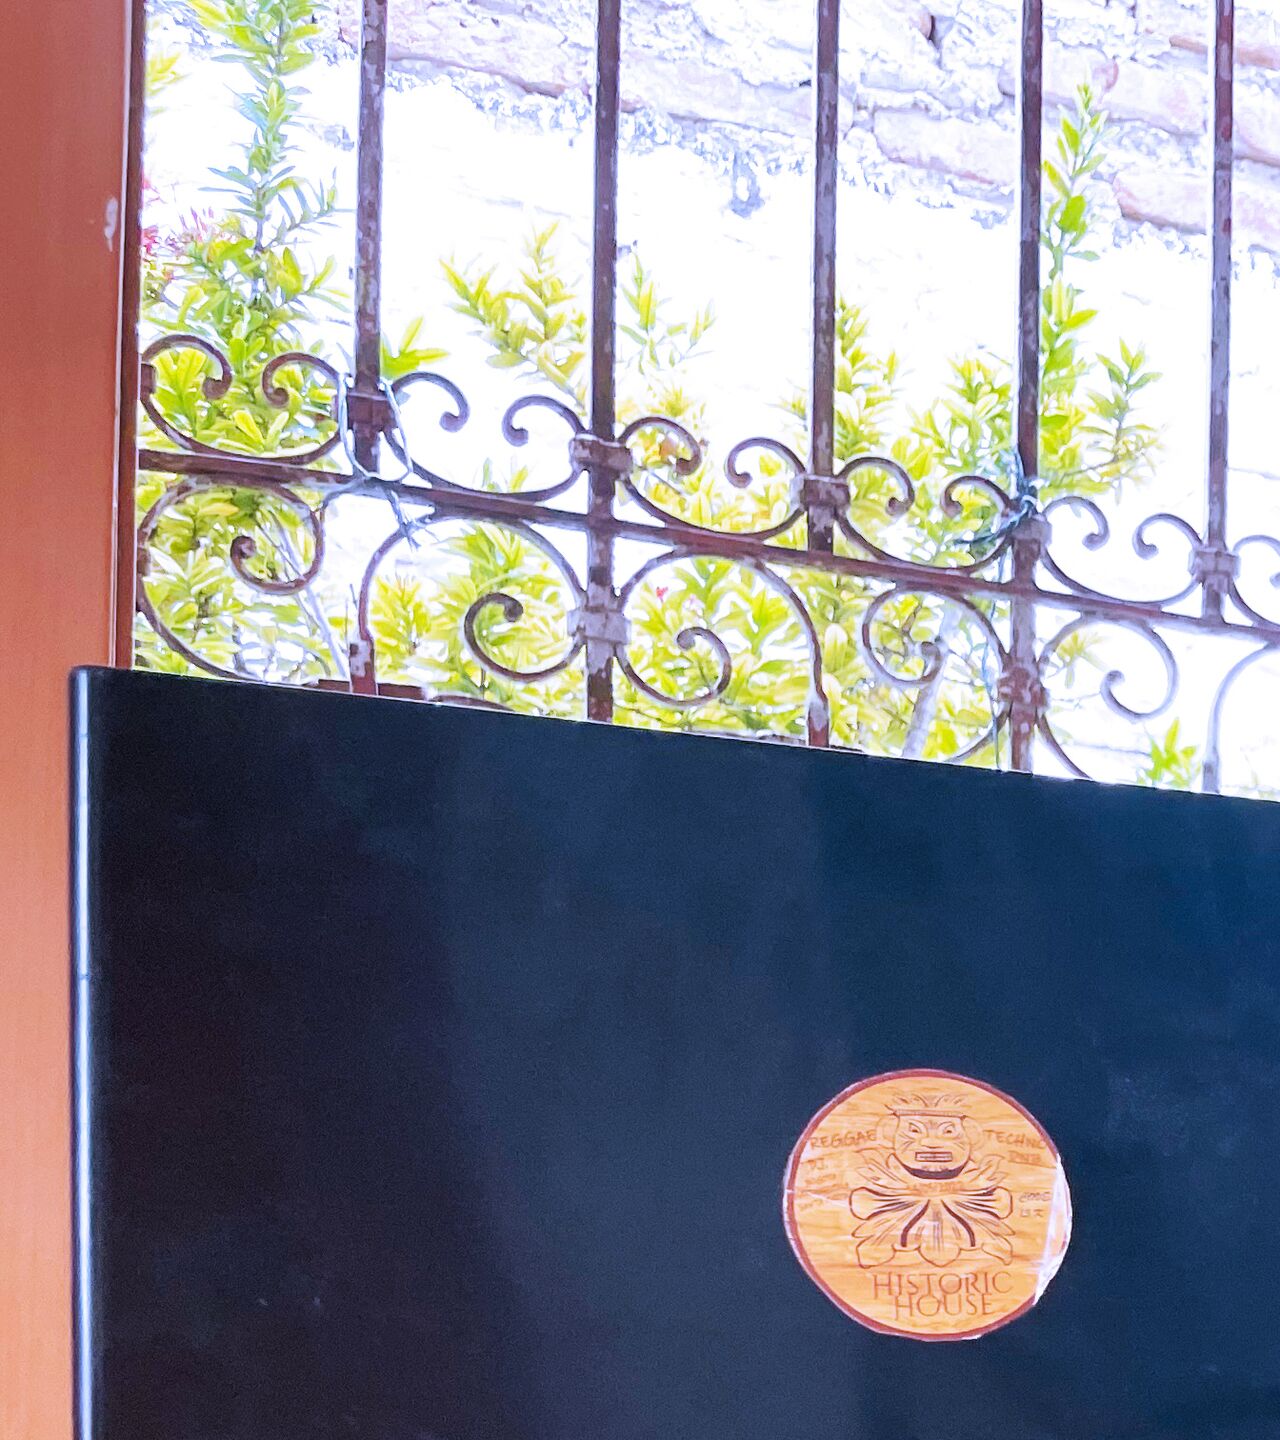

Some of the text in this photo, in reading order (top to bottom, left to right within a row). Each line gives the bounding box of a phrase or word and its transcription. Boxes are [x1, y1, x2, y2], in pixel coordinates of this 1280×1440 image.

[810, 1129, 877, 1150] REGGAE
[873, 1271, 1013, 1300] HISTORIC
[895, 1293, 994, 1321] HOUSE
